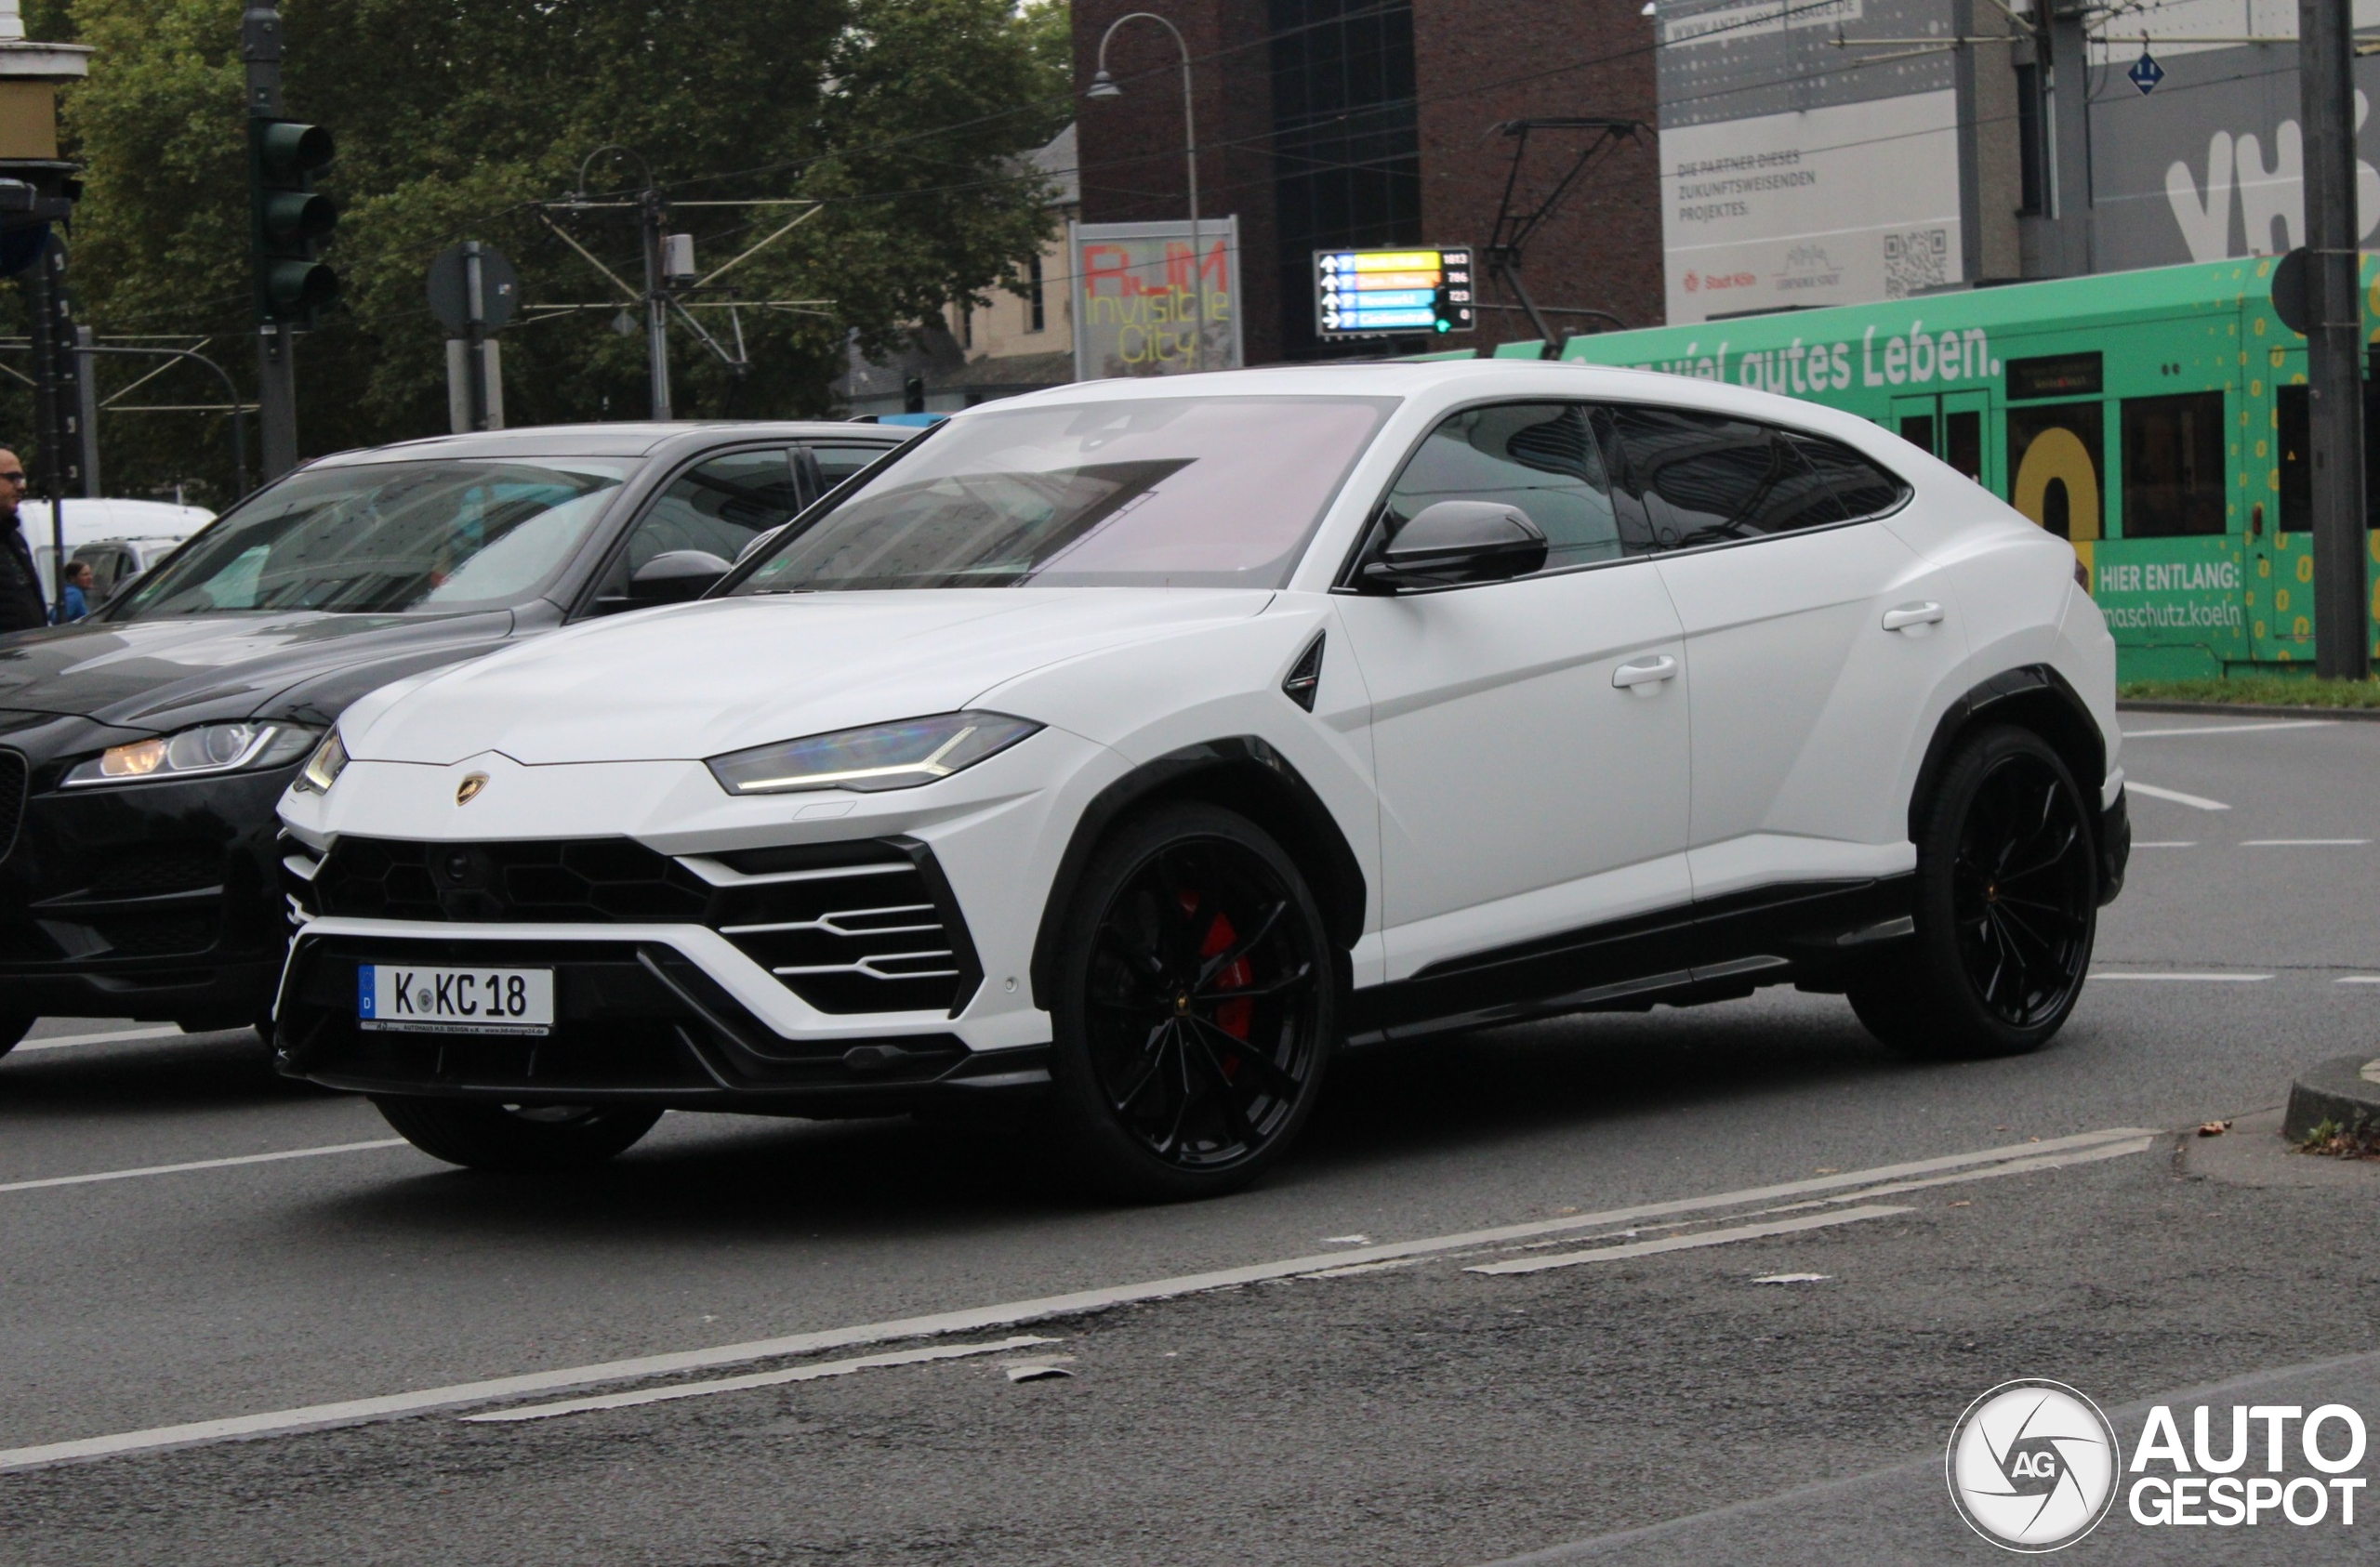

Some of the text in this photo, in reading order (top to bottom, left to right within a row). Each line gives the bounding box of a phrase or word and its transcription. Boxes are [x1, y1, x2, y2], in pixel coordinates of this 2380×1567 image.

[1677, 150, 1800, 178] DIE PARTNER DIESES
[1678, 170, 1816, 200] ZUKUNFTSWEISENDEN
[1085, 283, 1229, 325] Invisible
[1118, 324, 1197, 369] City
[1863, 321, 2000, 387] Leben.
[2100, 561, 2240, 592] HIER ENTLANG:
[364, 997, 371, 1009] D
[395, 972, 415, 1014] K
